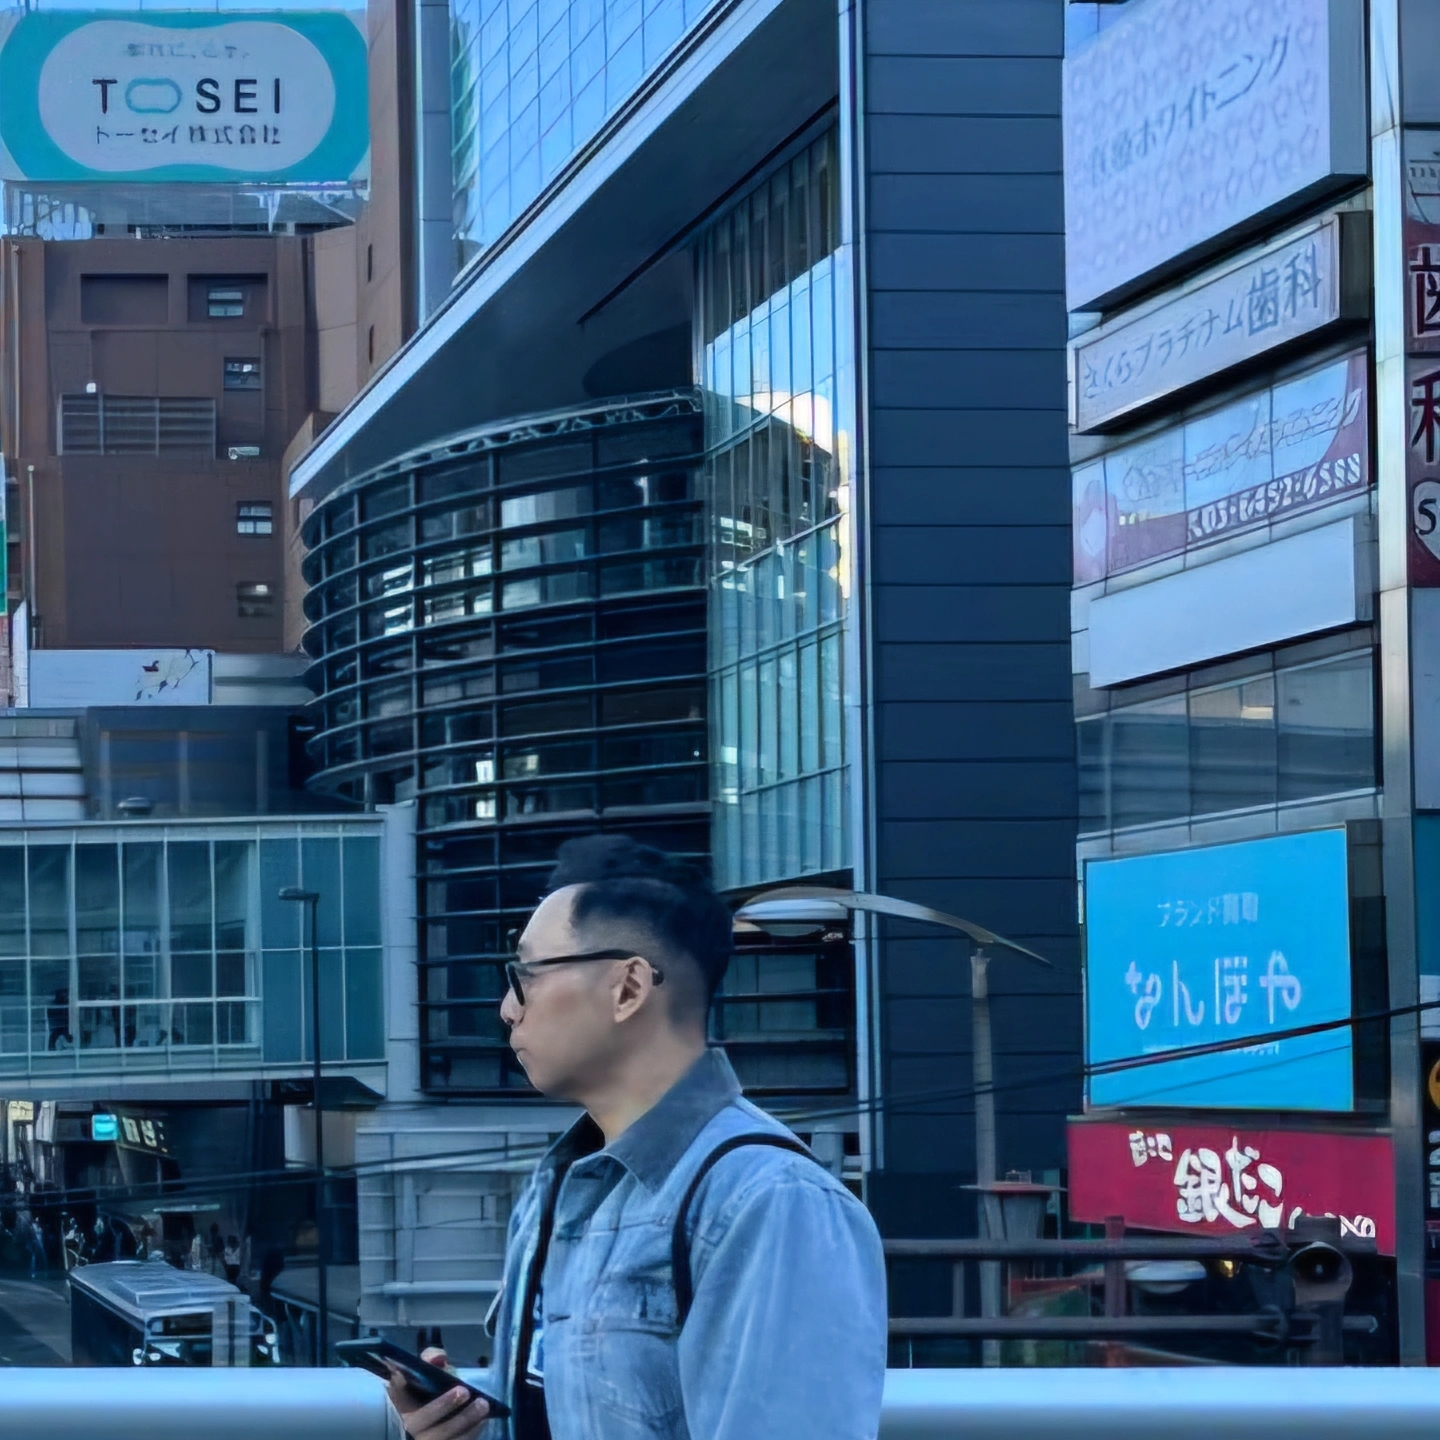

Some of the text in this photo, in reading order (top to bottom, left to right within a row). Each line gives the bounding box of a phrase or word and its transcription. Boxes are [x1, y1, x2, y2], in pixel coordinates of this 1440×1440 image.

[92, 77, 281, 115] TOSEI
[1124, 949, 1302, 1031] なんぼや
